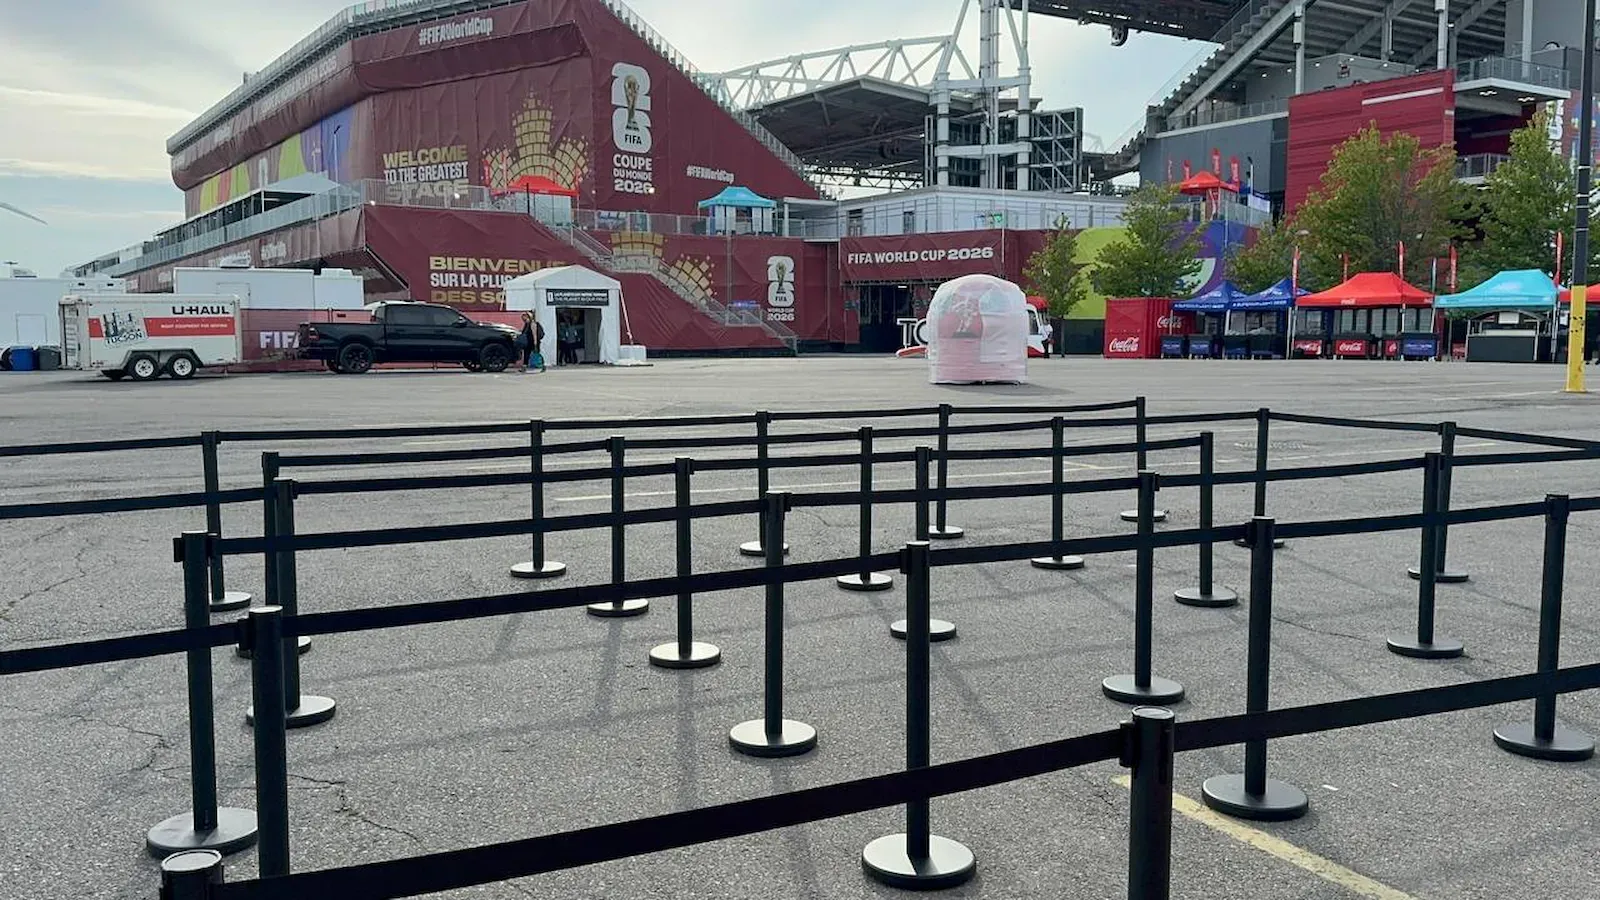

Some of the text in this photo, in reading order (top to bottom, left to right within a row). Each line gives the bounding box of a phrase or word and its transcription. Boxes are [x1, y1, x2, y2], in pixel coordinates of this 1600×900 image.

[419, 17, 493, 45] #FIFAWorldCup
[624, 134, 642, 144] FIFA
[383, 145, 467, 168] WELCOME
[613, 154, 652, 171] COUPE
[384, 161, 468, 185] TO THE GREATEST
[613, 168, 652, 181] DU MONDE
[614, 179, 653, 194] 2026
[848, 247, 993, 264] FIFA WORLD CUP 2026
[430, 273, 458, 288] SUR
[460, 274, 478, 288] LA
[430, 290, 477, 304] DES
[172, 305, 230, 315] U-HAUL
[767, 313, 794, 321] 2026
[1109, 337, 1139, 352] Coca-Cola
